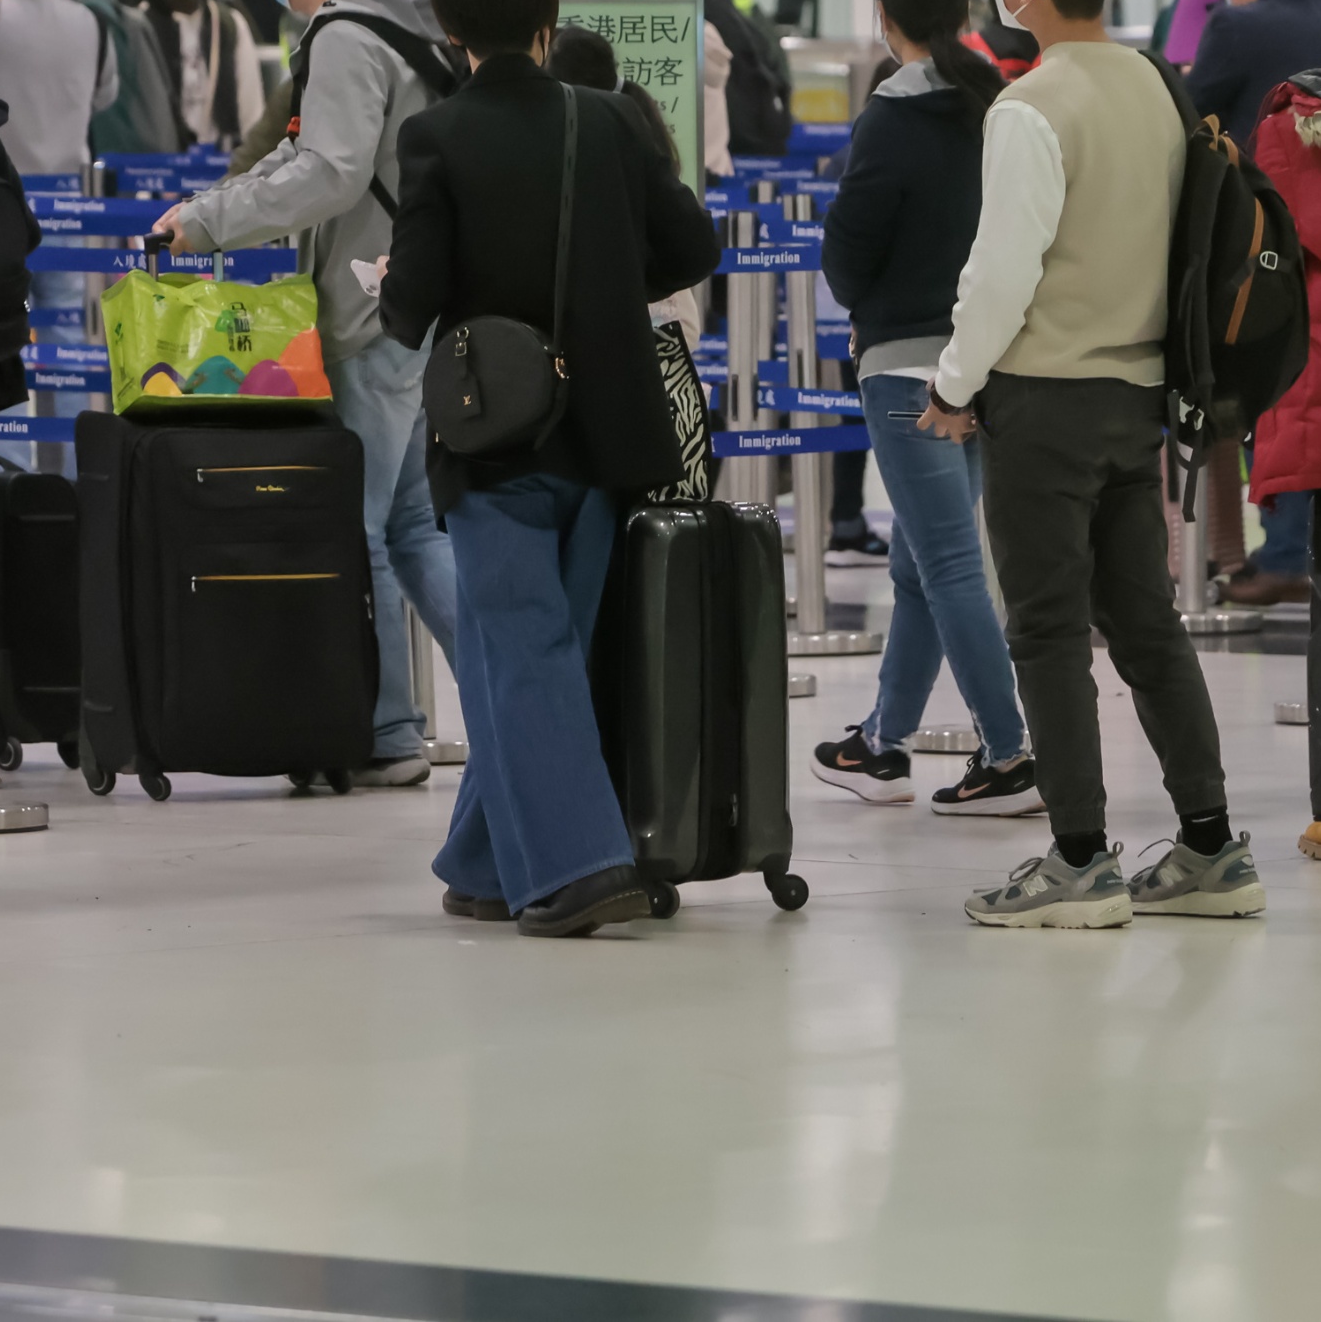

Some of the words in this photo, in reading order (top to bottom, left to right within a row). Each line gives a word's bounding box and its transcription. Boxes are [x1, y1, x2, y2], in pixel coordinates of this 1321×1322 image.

[737, 251, 801, 267] Immigration
[36, 373, 86, 387] Immigration
[798, 391, 860, 409] Immigration
[739, 434, 801, 450] Immigration
